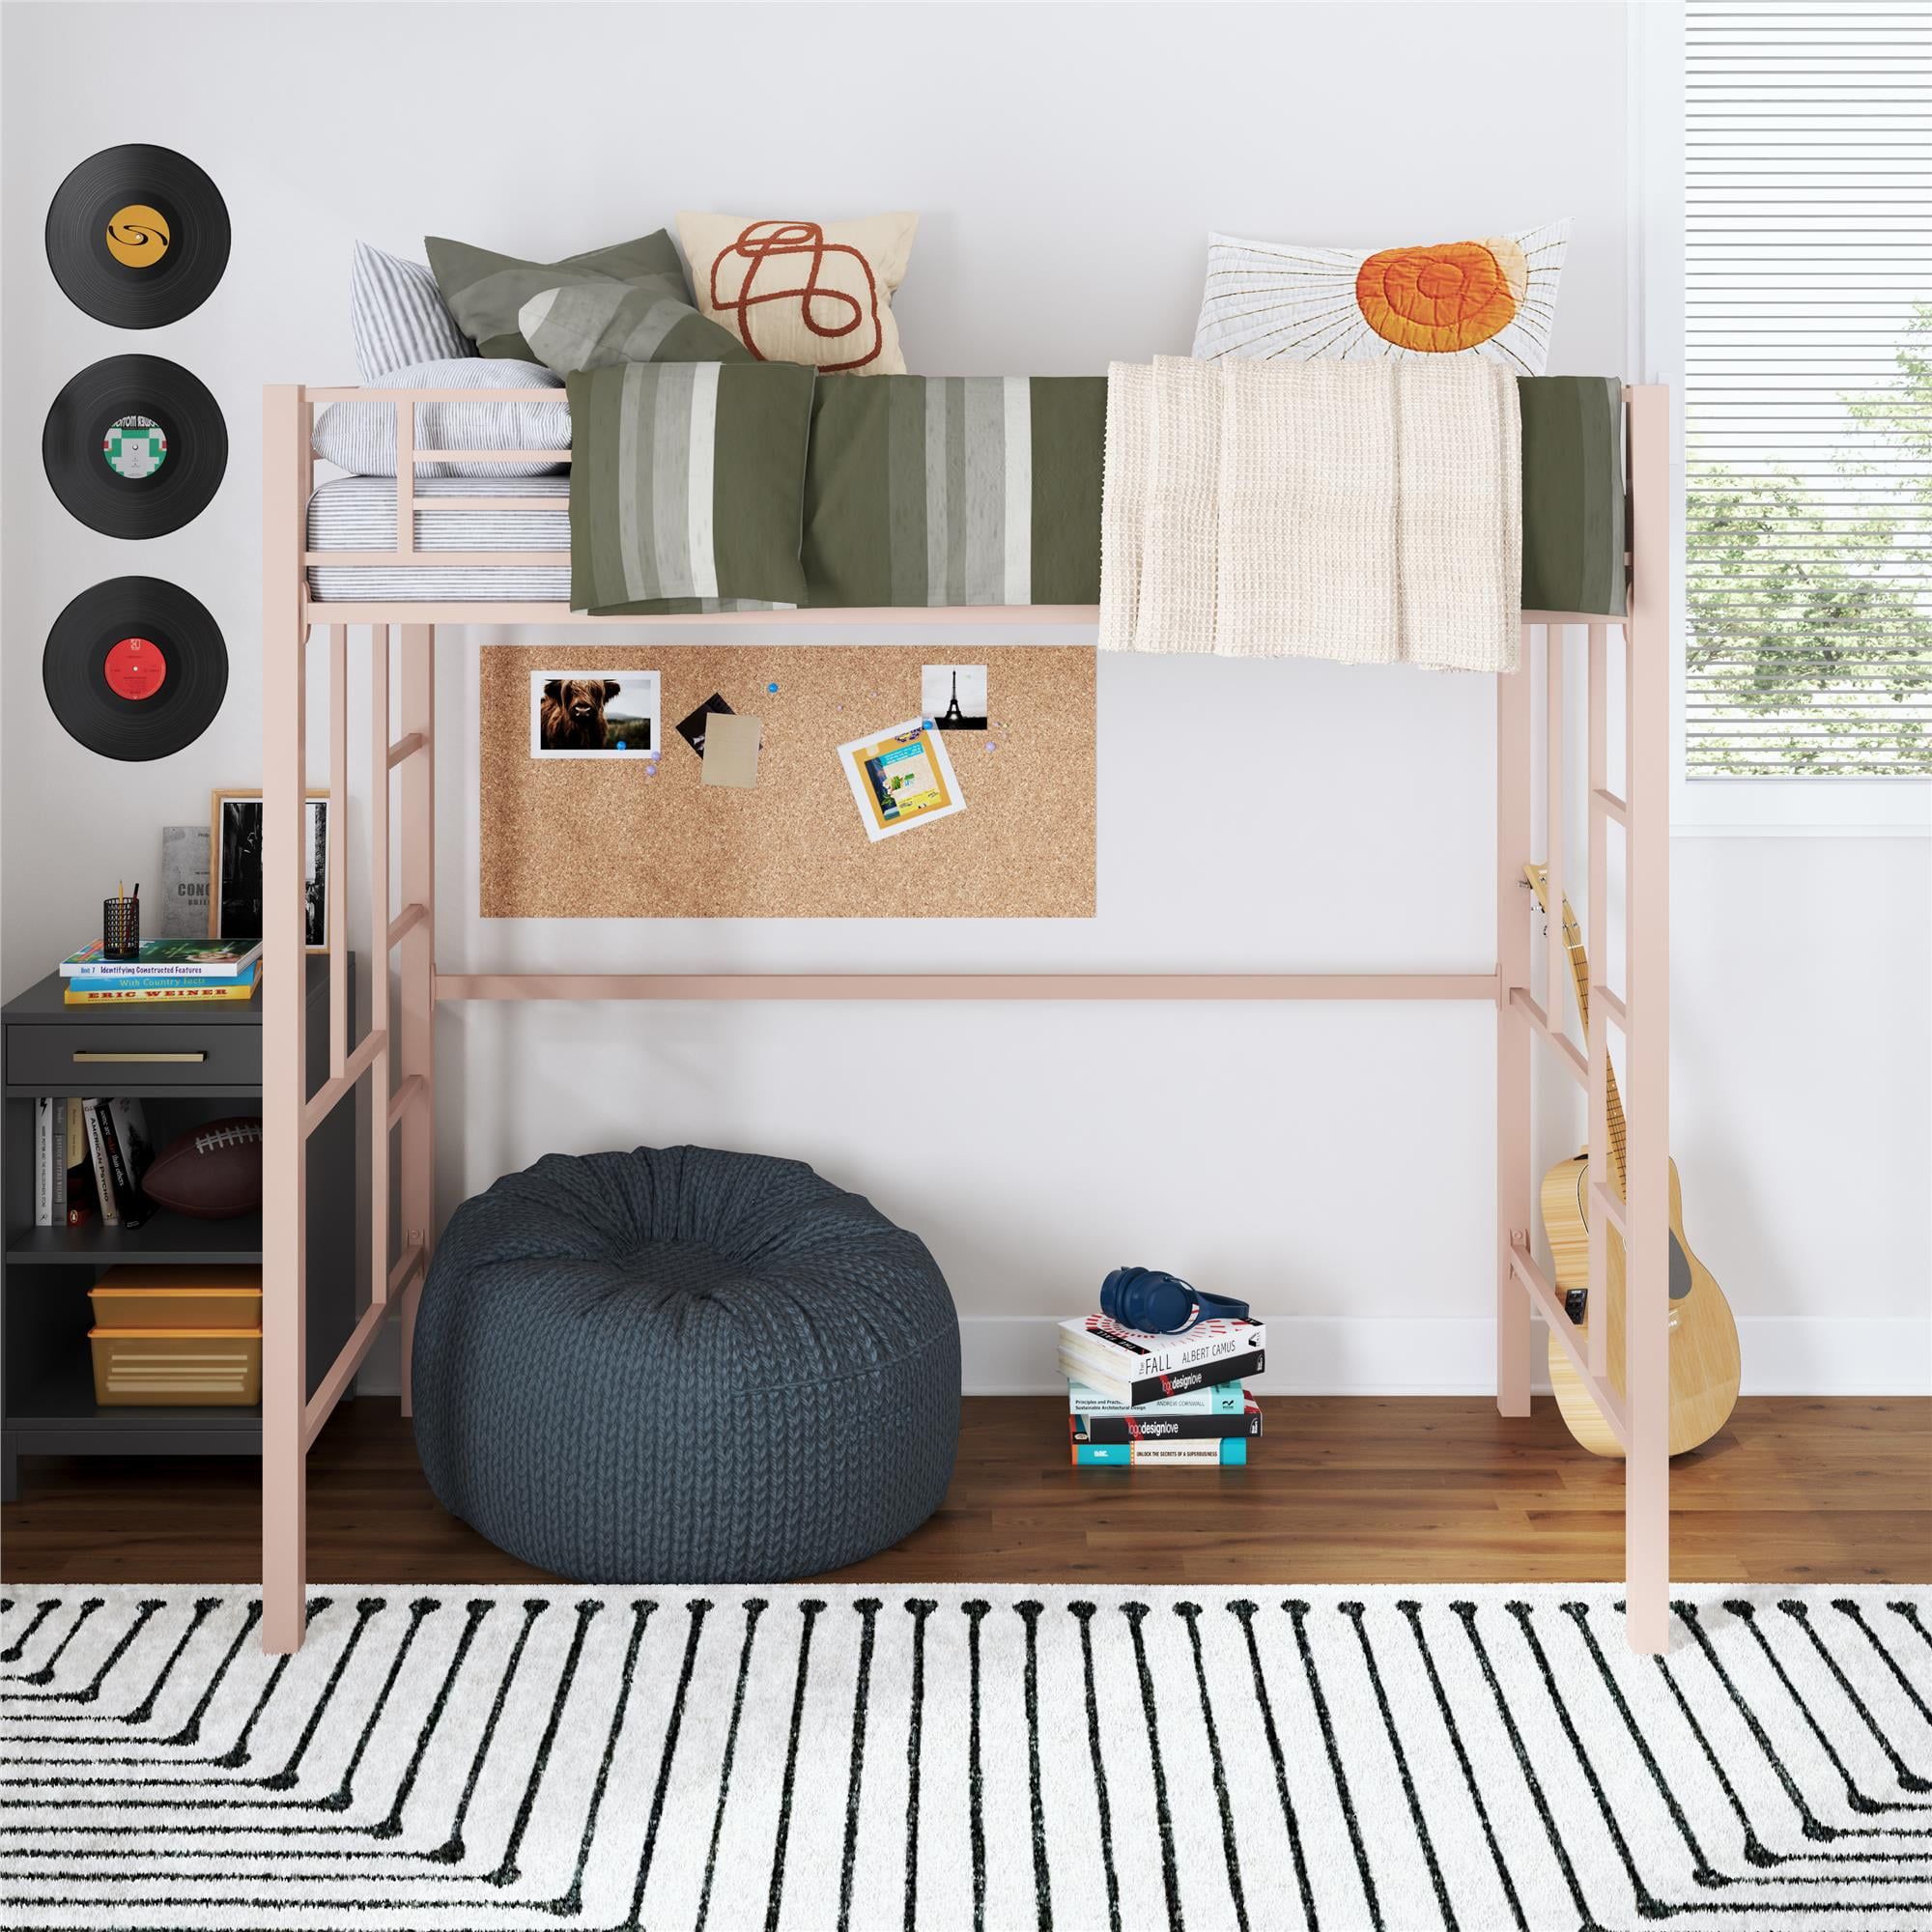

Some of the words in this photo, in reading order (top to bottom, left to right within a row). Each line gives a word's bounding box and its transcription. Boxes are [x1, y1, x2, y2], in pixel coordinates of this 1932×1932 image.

[100, 966, 135, 975] Identifying
[119, 979, 140, 987] With
[143, 979, 181, 987] Country
[146, 989, 229, 998] WEINER
[90, 1118, 102, 1164] AMERICAN
[1145, 1354, 1172, 1375] FALL
[1182, 1347, 1209, 1364] ALBERT
[1211, 1340, 1236, 1356] CAMUS
